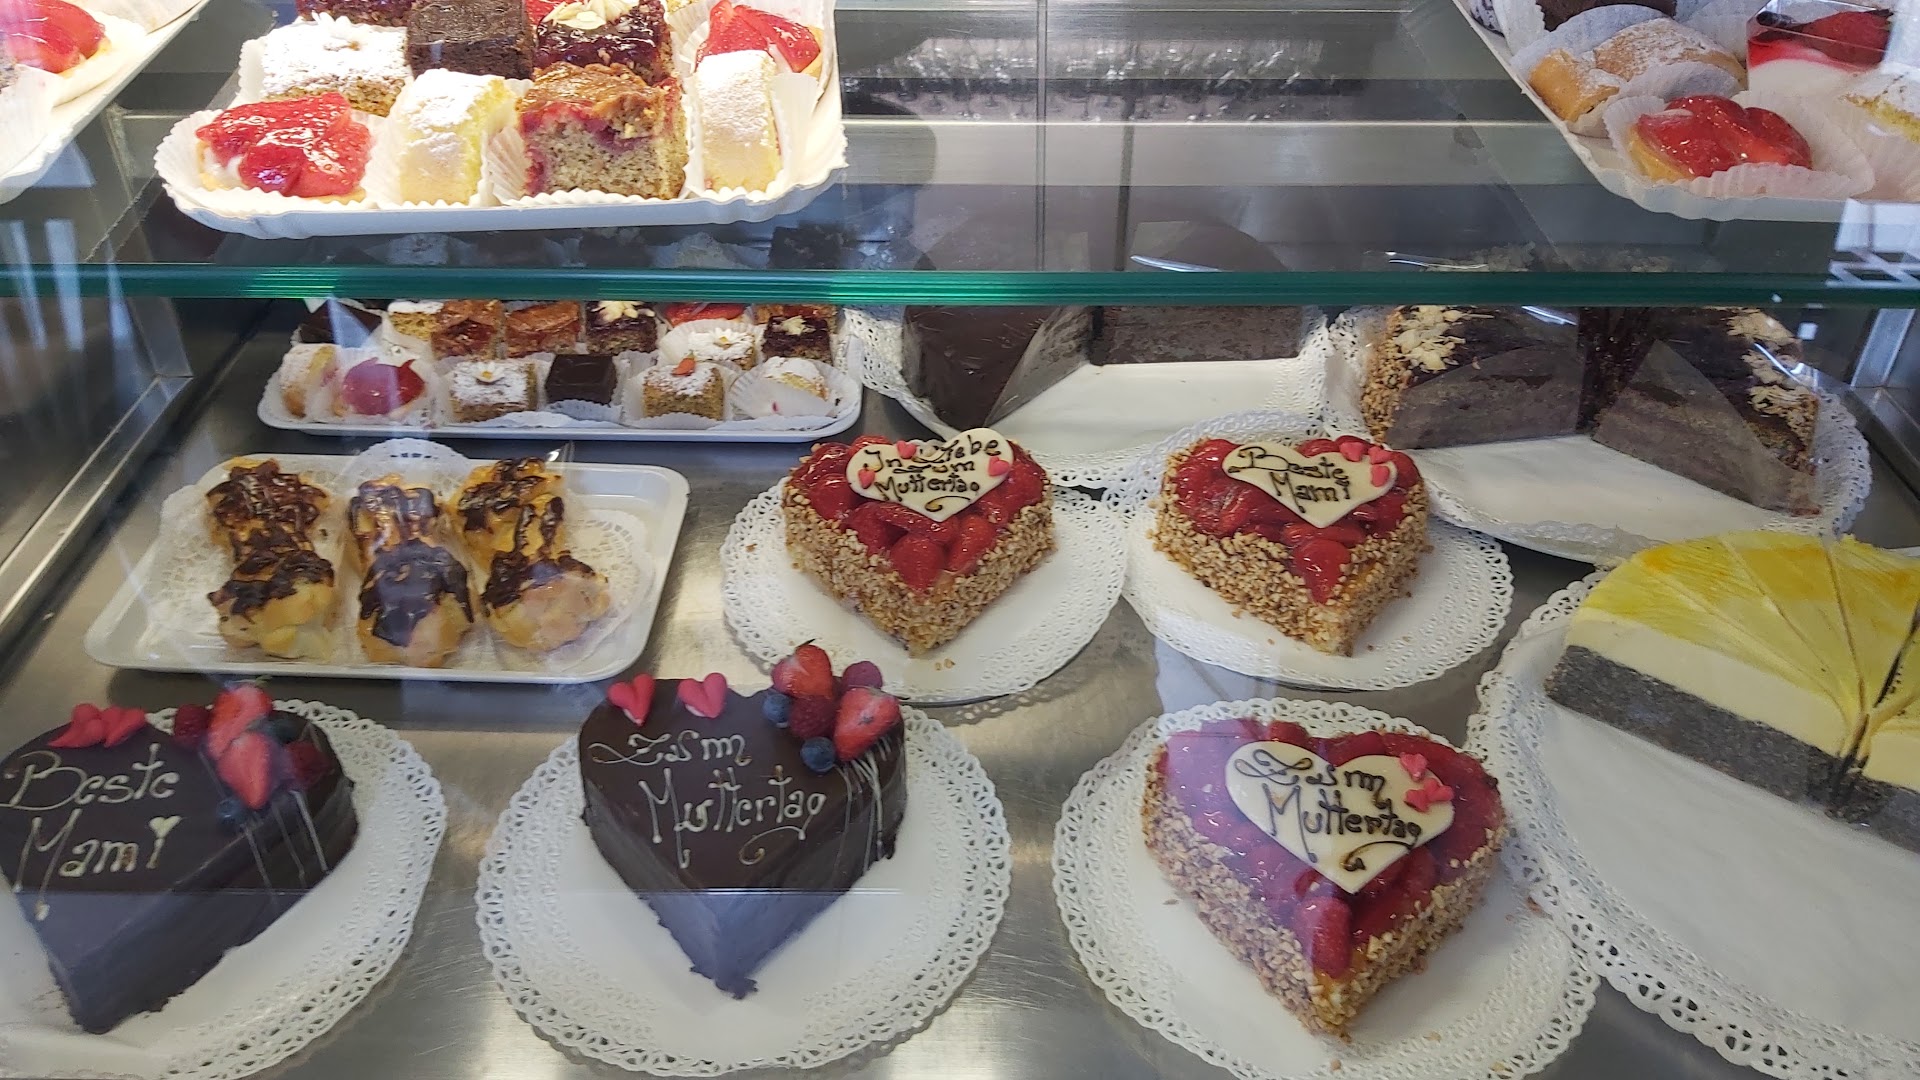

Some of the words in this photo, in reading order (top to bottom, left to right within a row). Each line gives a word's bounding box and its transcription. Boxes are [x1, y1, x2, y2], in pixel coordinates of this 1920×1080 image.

[863, 449, 902, 473] In
[1227, 446, 1350, 479] Beste
[873, 473, 981, 512] Muttertag
[1269, 471, 1351, 514] Mami
[0, 742, 181, 811] Beste
[638, 765, 827, 869] Muttertag
[1262, 782, 1422, 872] Muttertag
